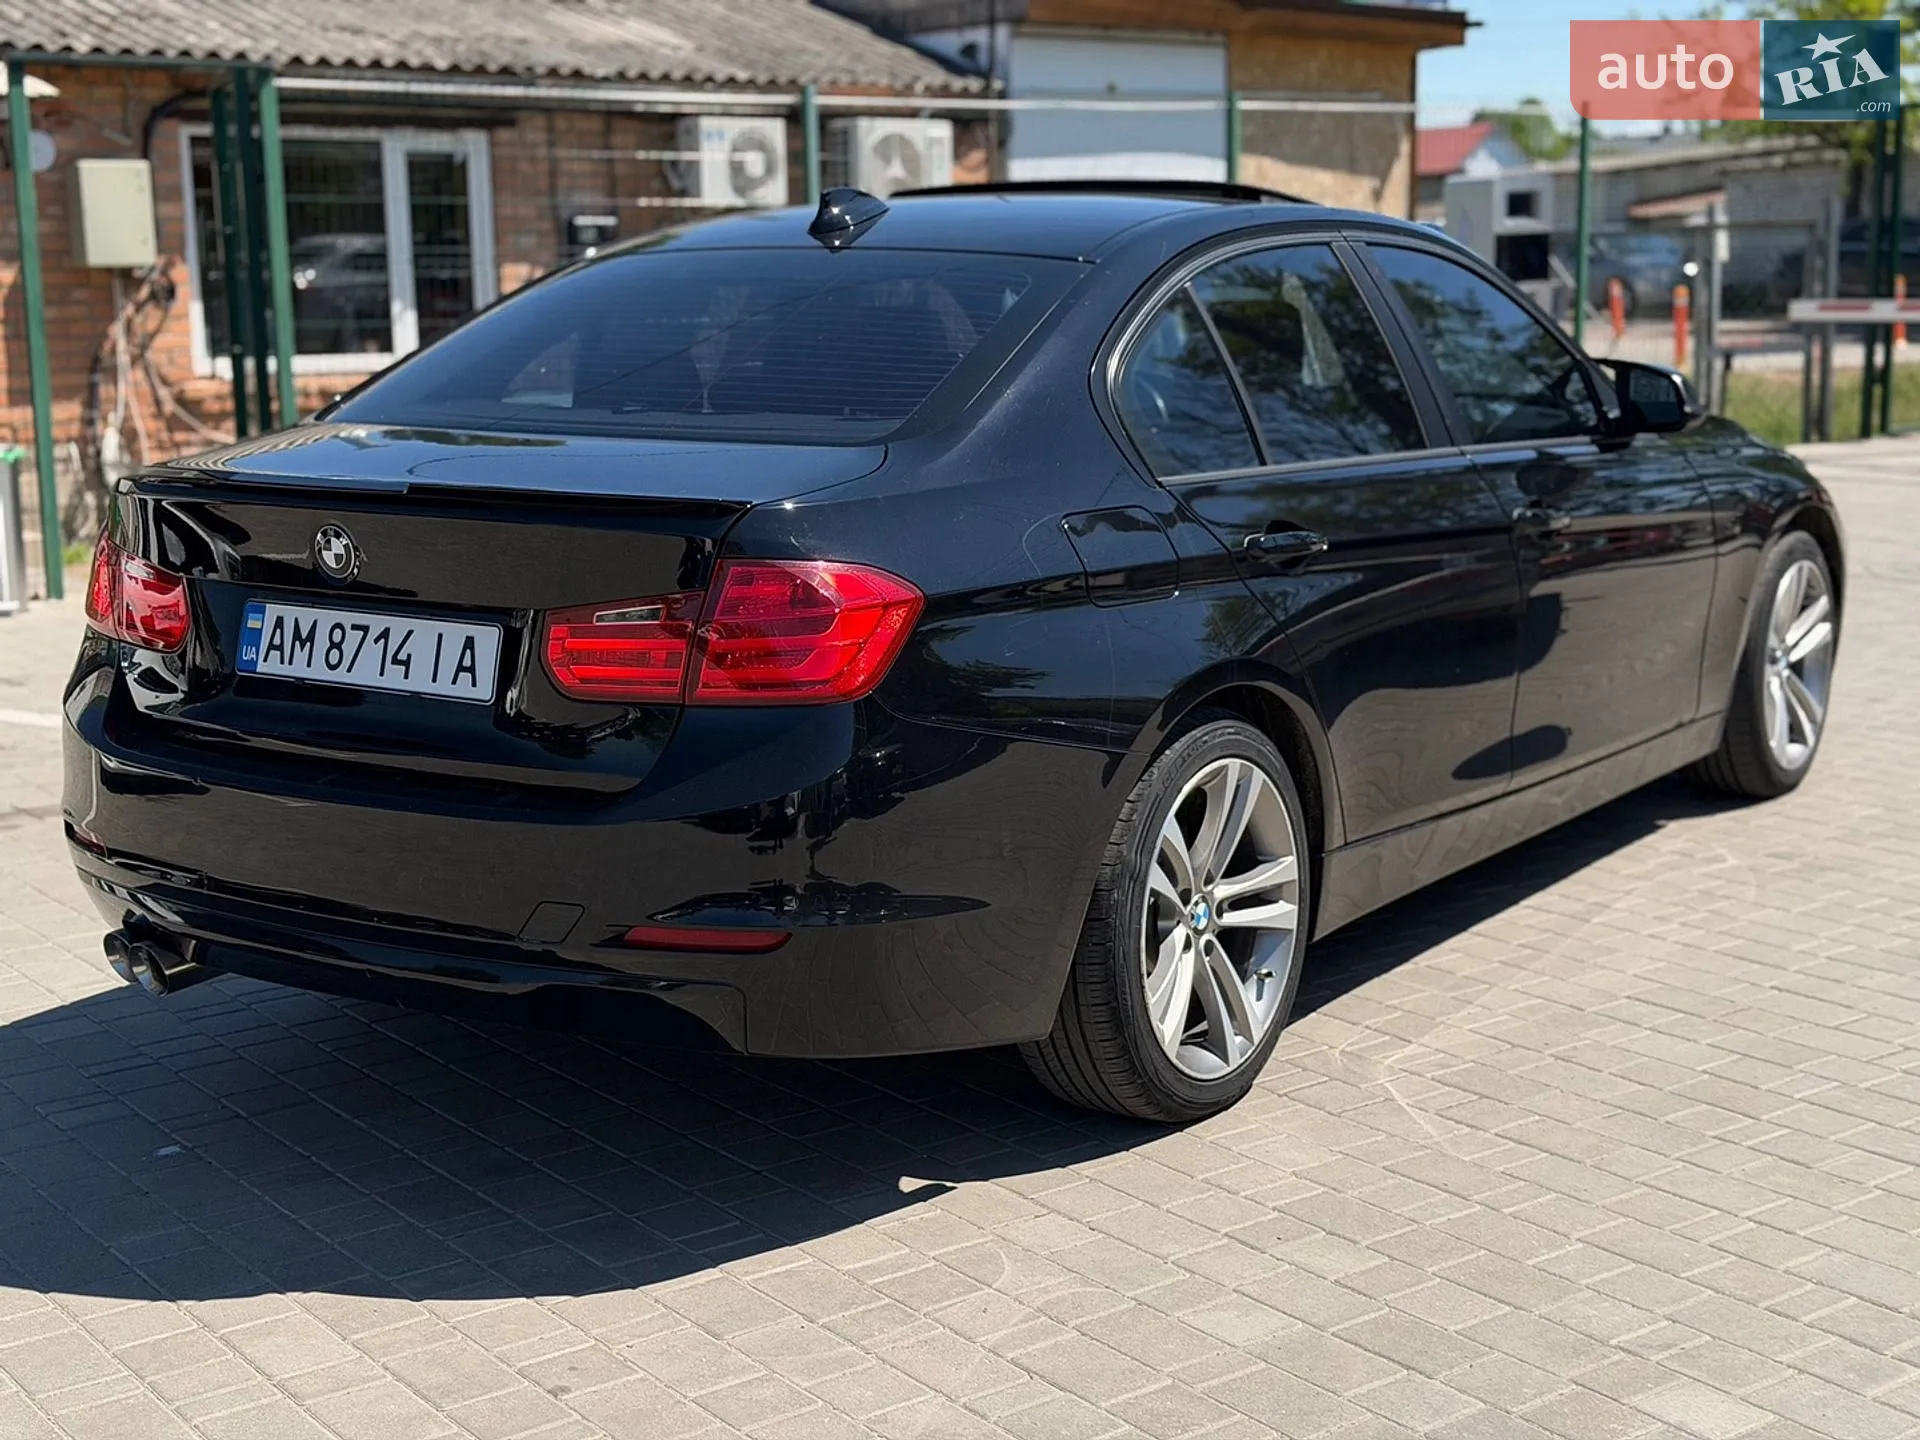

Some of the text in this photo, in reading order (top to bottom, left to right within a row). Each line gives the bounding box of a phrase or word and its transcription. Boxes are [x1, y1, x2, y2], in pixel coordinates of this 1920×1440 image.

[242, 644, 257, 662] UA
[262, 615, 477, 688] AM 8714 IA
